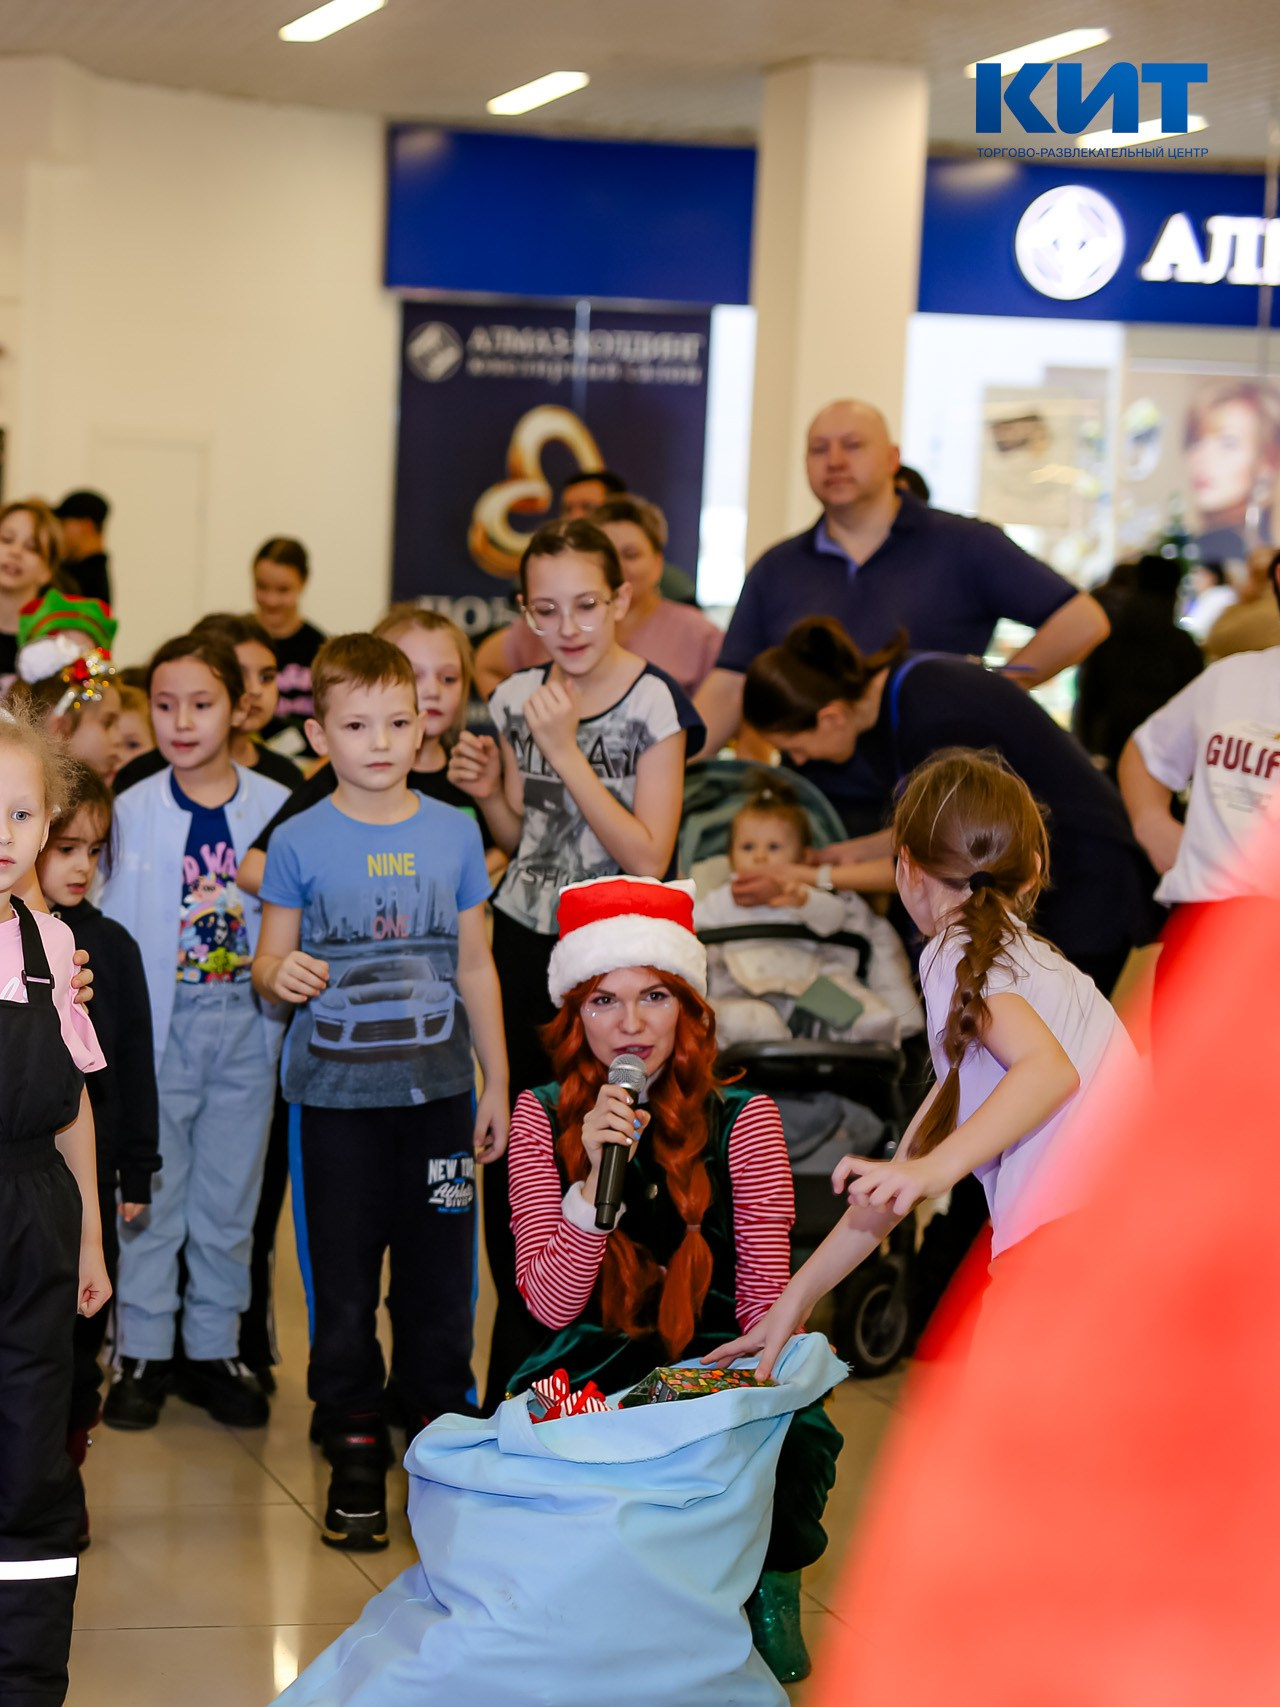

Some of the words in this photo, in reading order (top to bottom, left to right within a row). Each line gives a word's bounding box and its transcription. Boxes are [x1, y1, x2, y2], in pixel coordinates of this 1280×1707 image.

[1140, 211, 1280, 286] АЛ
[367, 852, 416, 878] NINE
[373, 914, 411, 941] ONE
[427, 1158, 458, 1186] NEW
